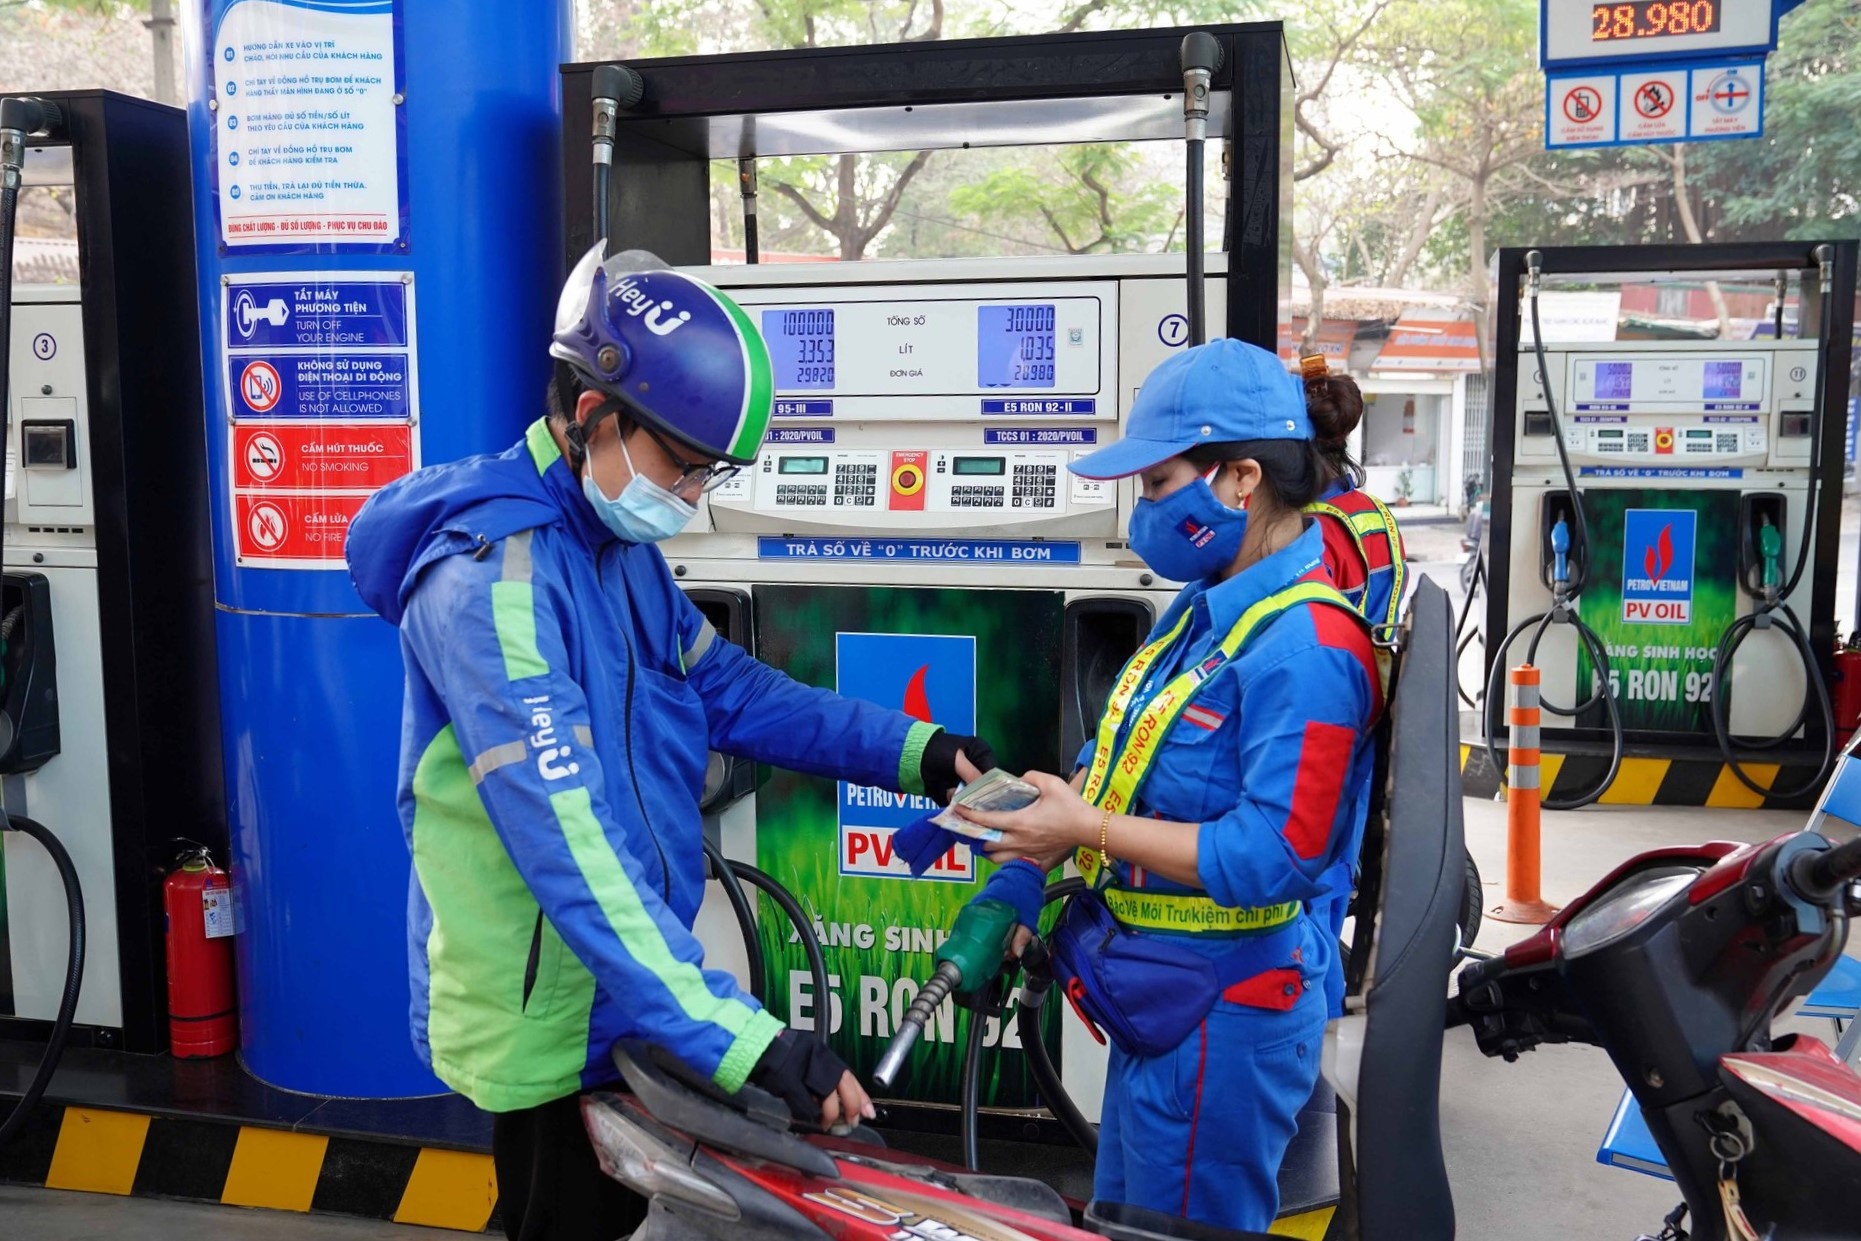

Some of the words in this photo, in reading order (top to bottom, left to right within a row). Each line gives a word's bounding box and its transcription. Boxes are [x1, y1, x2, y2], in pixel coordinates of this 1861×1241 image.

[1592, 0, 1712, 38] 28.980
[331, 51, 358, 60] KHÁCH
[360, 51, 382, 60] HÀNG
[355, 75, 382, 84] KHÁCH
[312, 122, 339, 130] KHÁCH
[341, 122, 364, 130] HÀNG
[324, 156, 338, 164] TRA
[303, 192, 324, 200] HÀNG
[358, 220, 372, 230] CHU
[295, 288, 314, 300] TẮT
[315, 288, 338, 300] MÁY
[296, 302, 342, 312] PHƯƠNG
[344, 302, 366, 315] TIỆN
[296, 321, 320, 330] TURN
[322, 320, 342, 330] OFF
[784, 312, 834, 336] 100000
[887, 315, 910, 326] TỔNG
[914, 315, 926, 326] SỐ
[1006, 307, 1054, 332] 30000
[1170, 322, 1180, 338] 7
[296, 333, 324, 342] YOUR
[326, 332, 364, 342] ENGINE
[41, 339, 48, 352] 3
[798, 340, 834, 364] 3,353
[899, 342, 913, 354] LÍT
[298, 360, 333, 370] KHÔNG
[336, 359, 350, 370] SỬ
[352, 361, 382, 373] DỤNG
[890, 370, 908, 378] ĐƠN
[908, 367, 924, 378] GIÁ
[1014, 364, 1054, 380] 28980
[298, 371, 320, 384] ĐIỆN
[322, 372, 352, 384] THOẠI
[356, 372, 368, 382] DI
[369, 370, 402, 384] ĐỘNG
[797, 367, 834, 382] 29820
[299, 392, 316, 400] USE
[318, 392, 332, 400] OF
[334, 392, 400, 400] CELLPHONES
[300, 404, 307, 412] IS
[309, 404, 330, 412] NOT
[330, 404, 382, 412] ALLOWED
[778, 404, 806, 414] 95-III
[1004, 402, 1018, 412] E5
[1020, 402, 1042, 412] RON
[1046, 402, 1072, 412] 92-II
[780, 431, 824, 440] 2020/PVOIL
[996, 432, 1018, 440] TCCS
[1020, 432, 1030, 440] 01
[1038, 431, 1084, 441] 2020/PVOIL
[301, 442, 324, 453] CẤM
[327, 442, 346, 453] HÚT
[348, 442, 384, 453] THUỐC
[302, 462, 318, 472] NO
[320, 462, 368, 472] SMOKING
[304, 513, 328, 524] CẤM
[330, 513, 348, 524] LỬA
[306, 532, 321, 542] NO
[324, 532, 342, 542] FIRE
[786, 540, 816, 556] TRẢ
[823, 540, 846, 556] SỐ
[850, 540, 872, 556] VỀ
[910, 543, 968, 558] TRƯỚC
[974, 546, 1002, 558] KHI
[1012, 546, 1050, 560] BƠM
[1627, 578, 1688, 592] PETROVIETNAM
[1626, 602, 1652, 618] PV
[1655, 604, 1686, 618] OIL
[1644, 646, 1680, 659] SINH
[1684, 647, 1718, 663] HỌC
[1628, 670, 1678, 701] RON
[1685, 672, 1712, 702] 92
[1132, 714, 1157, 754] RON
[1098, 746, 1108, 768] E5
[1122, 752, 1138, 774] 92
[1104, 790, 1122, 814] E5
[848, 832, 893, 867] PV
[1078, 851, 1094, 871] 92
[1141, 902, 1162, 920] Môi
[1192, 905, 1230, 929] kiệm
